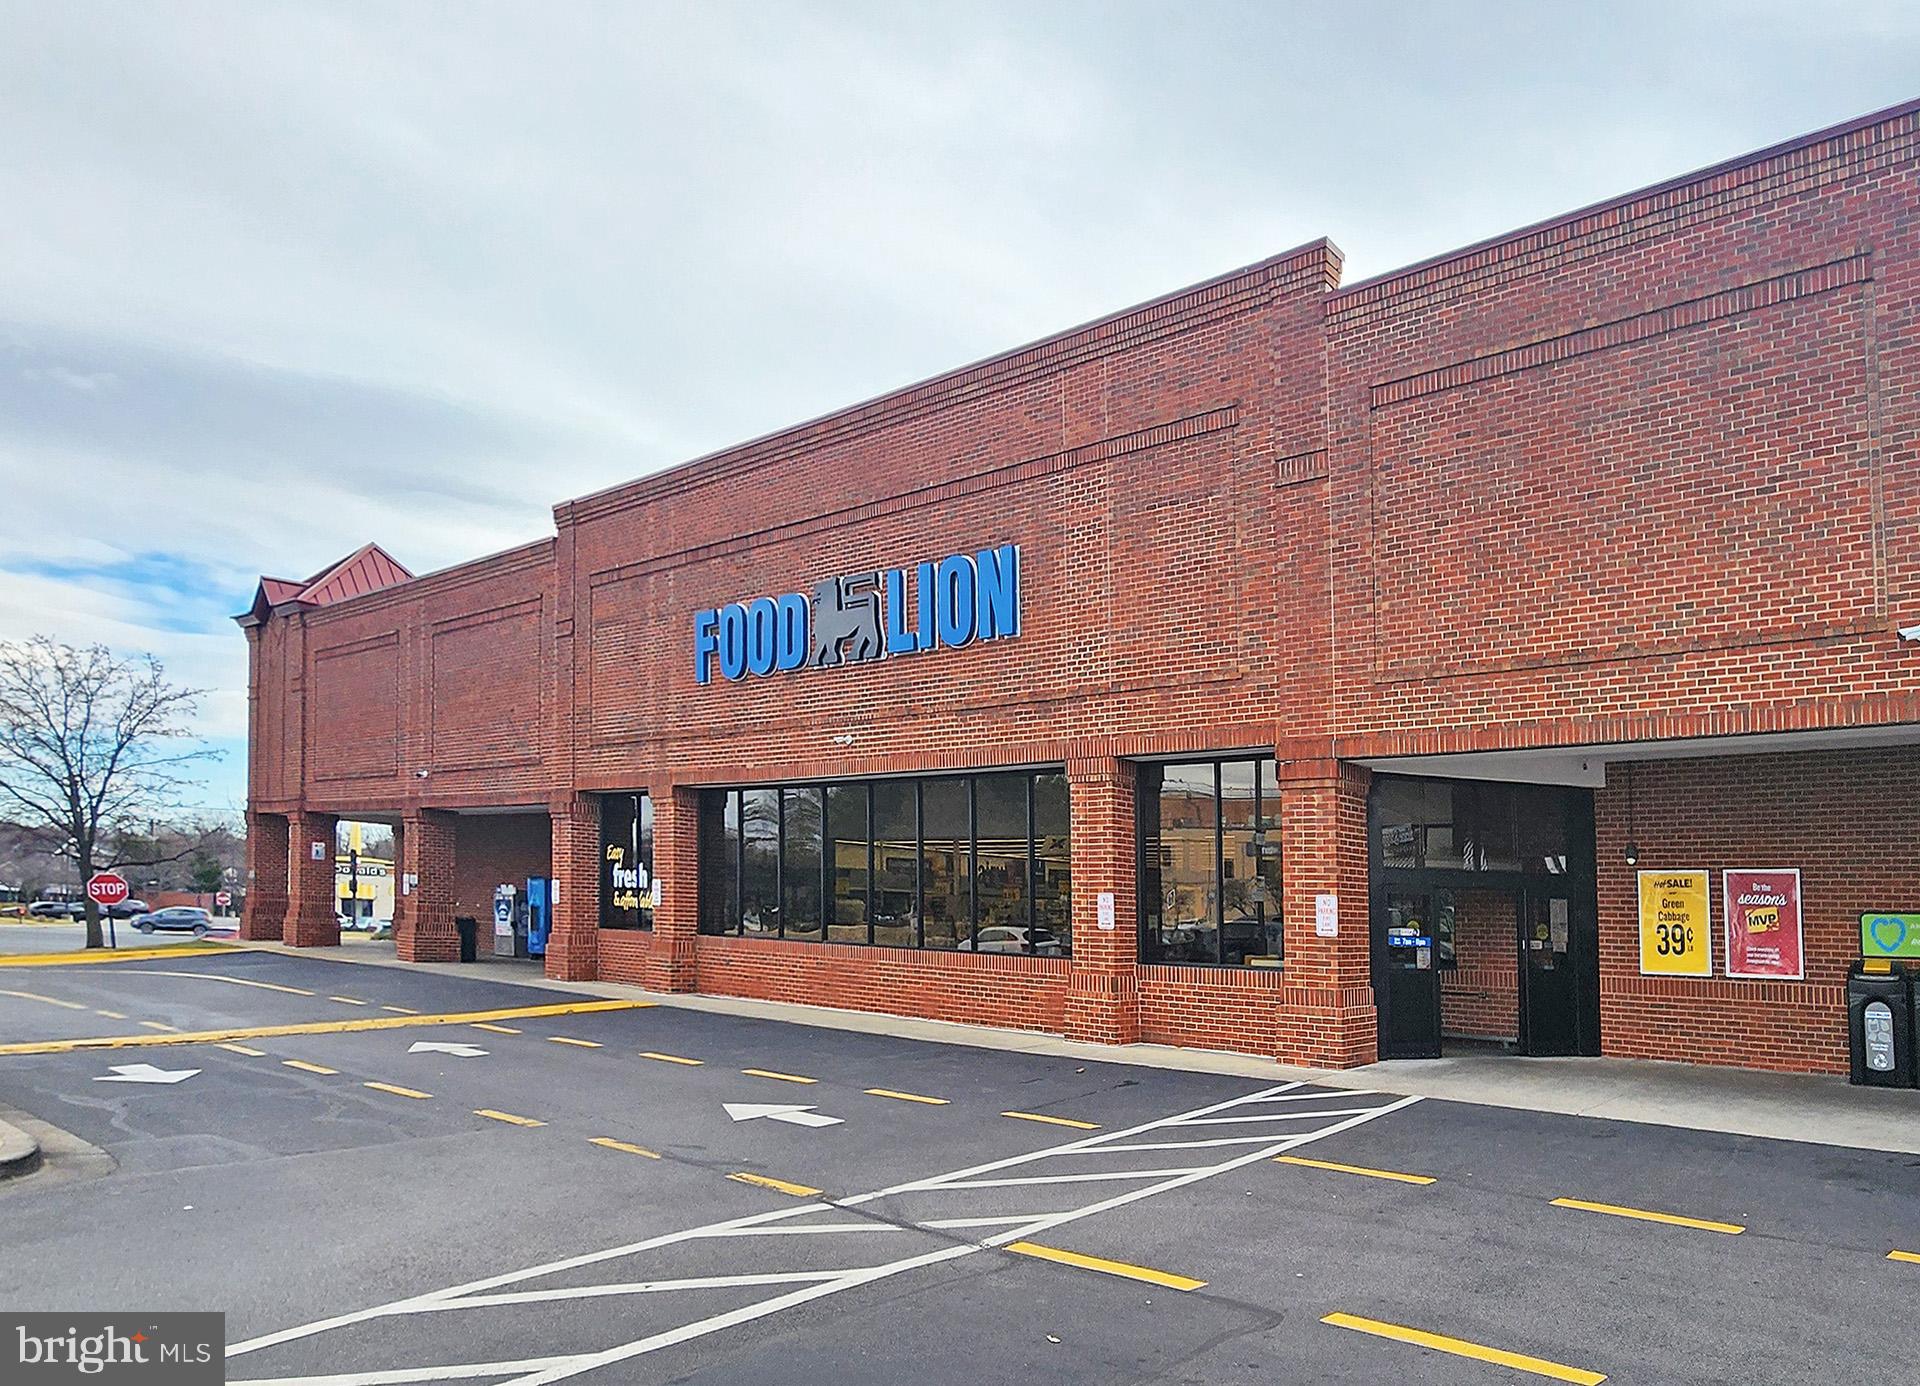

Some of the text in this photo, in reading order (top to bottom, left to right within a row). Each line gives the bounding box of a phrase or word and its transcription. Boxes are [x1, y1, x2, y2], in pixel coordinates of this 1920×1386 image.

[694, 544, 1021, 686] FOOD LION
[606, 844, 625, 867] Easy
[613, 862, 648, 888] fresh
[91, 882, 125, 895] STOP
[1667, 878, 1693, 888] SALE!
[1752, 882, 1772, 891] Be the
[1662, 898, 1685, 909] Green
[1737, 893, 1788, 906] season's
[1658, 911, 1690, 923] Cabbage
[1748, 914, 1777, 926] MVP
